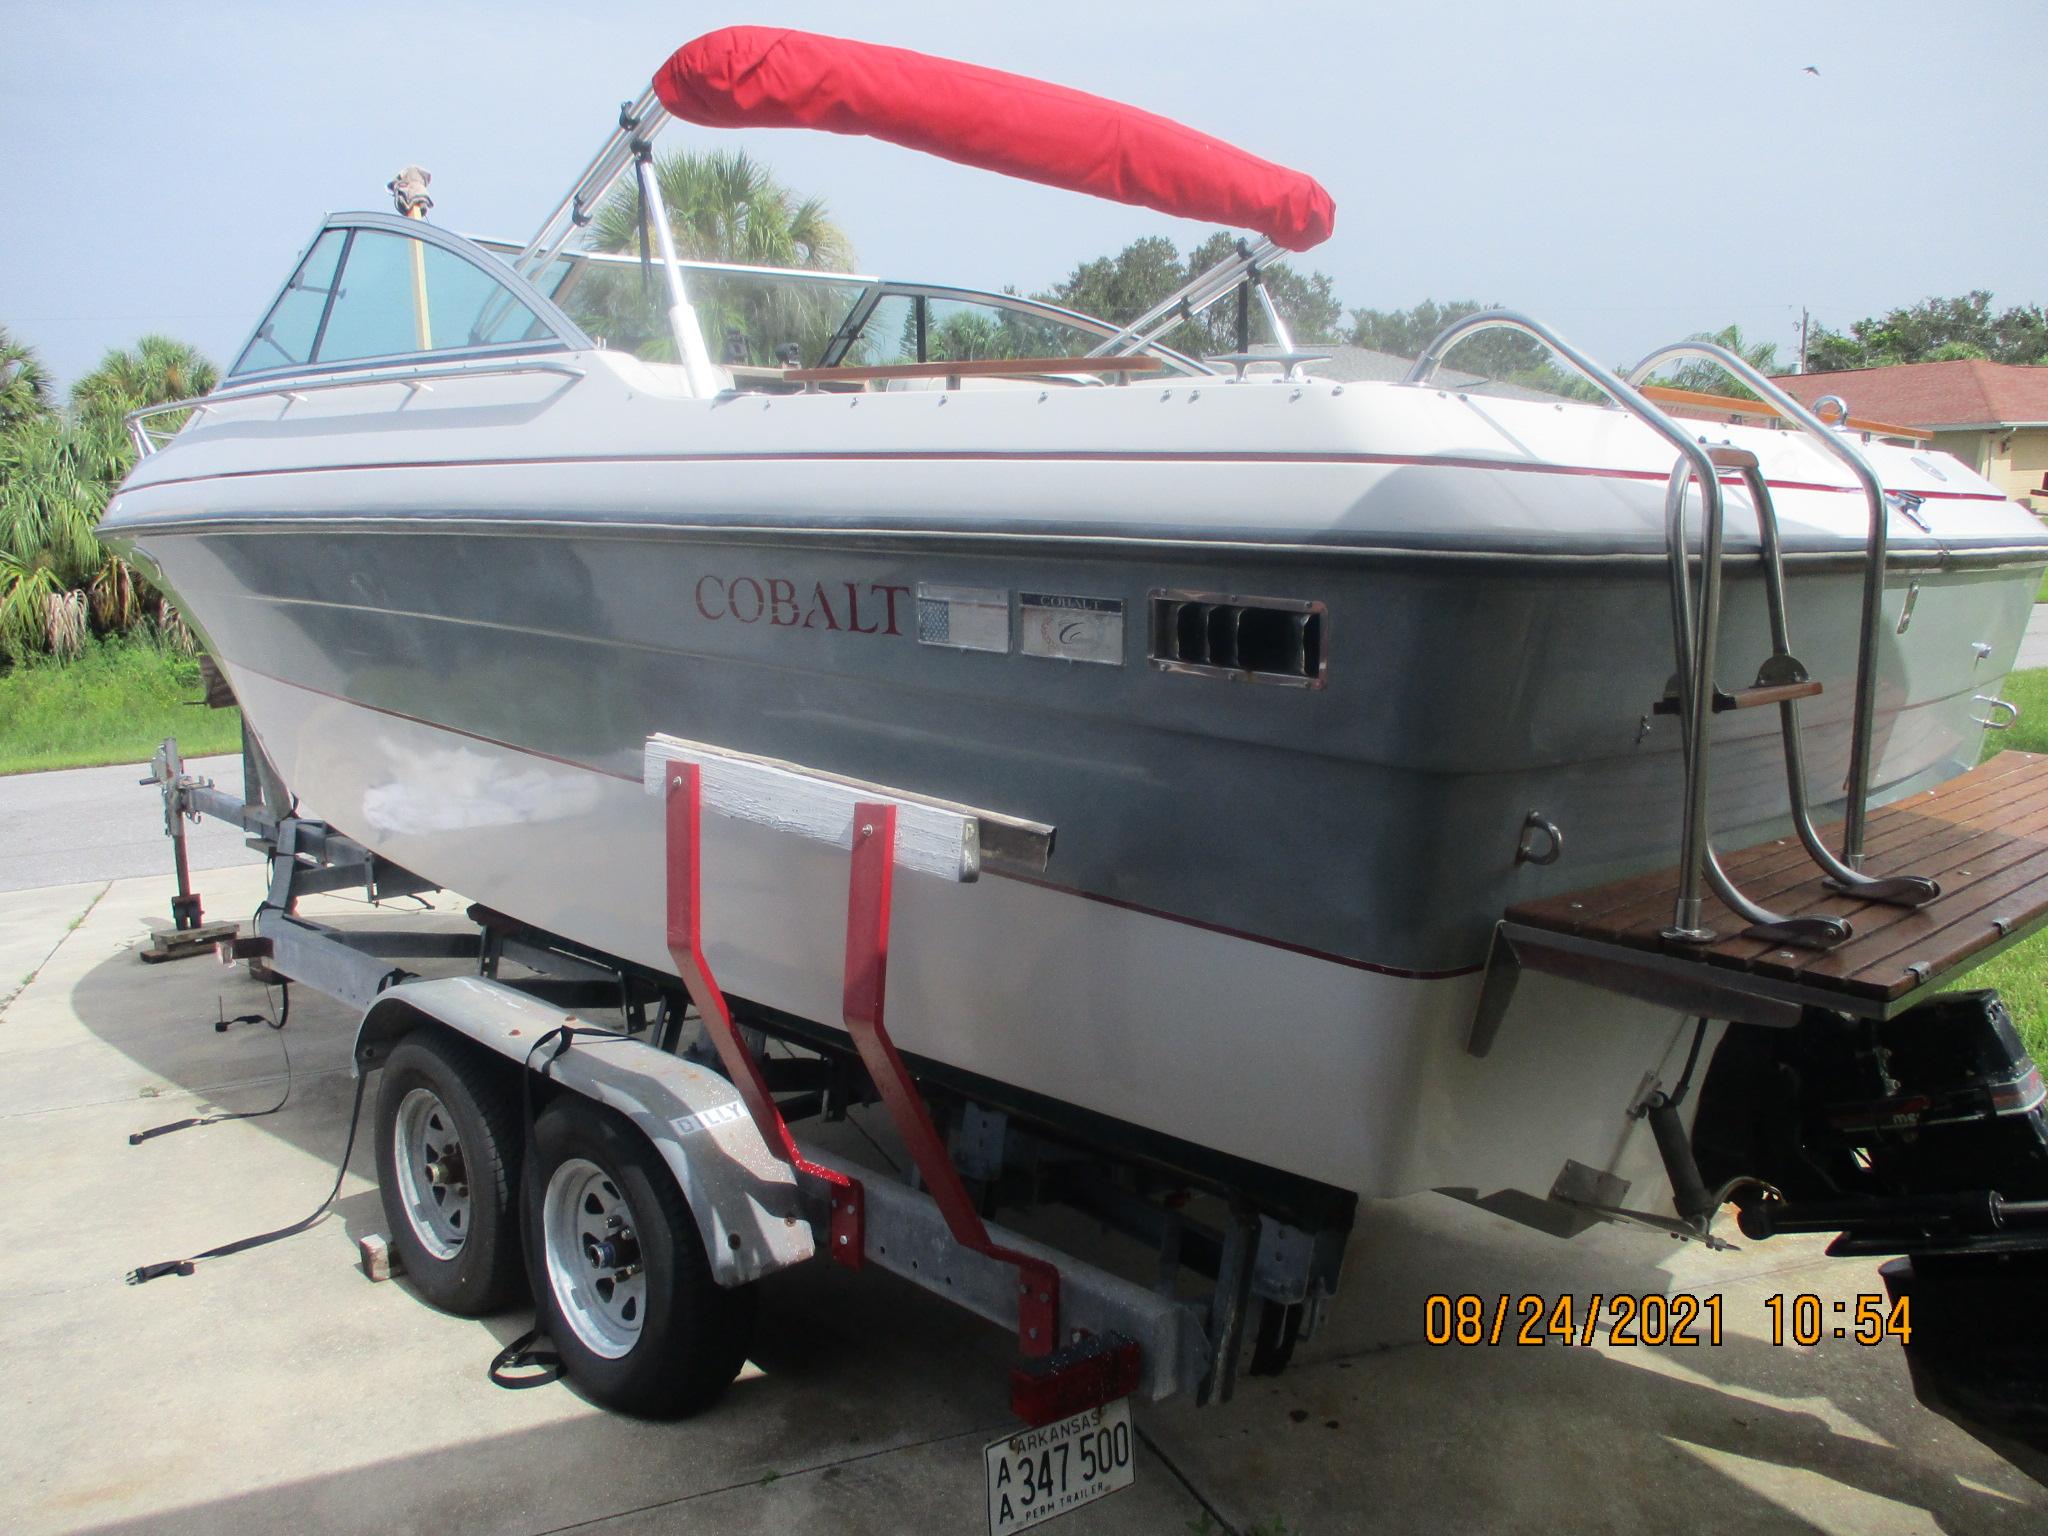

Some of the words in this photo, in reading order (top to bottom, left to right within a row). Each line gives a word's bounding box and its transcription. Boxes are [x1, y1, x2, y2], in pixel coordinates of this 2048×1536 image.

[696, 575, 911, 636] COBALT
[1017, 1412, 1101, 1454] ARKANSAS
[1018, 1442, 1069, 1505] 347
[1080, 1421, 1129, 1481] 500
[1026, 1503, 1055, 1520] PERM
[1060, 1484, 1103, 1506] TRAILER
